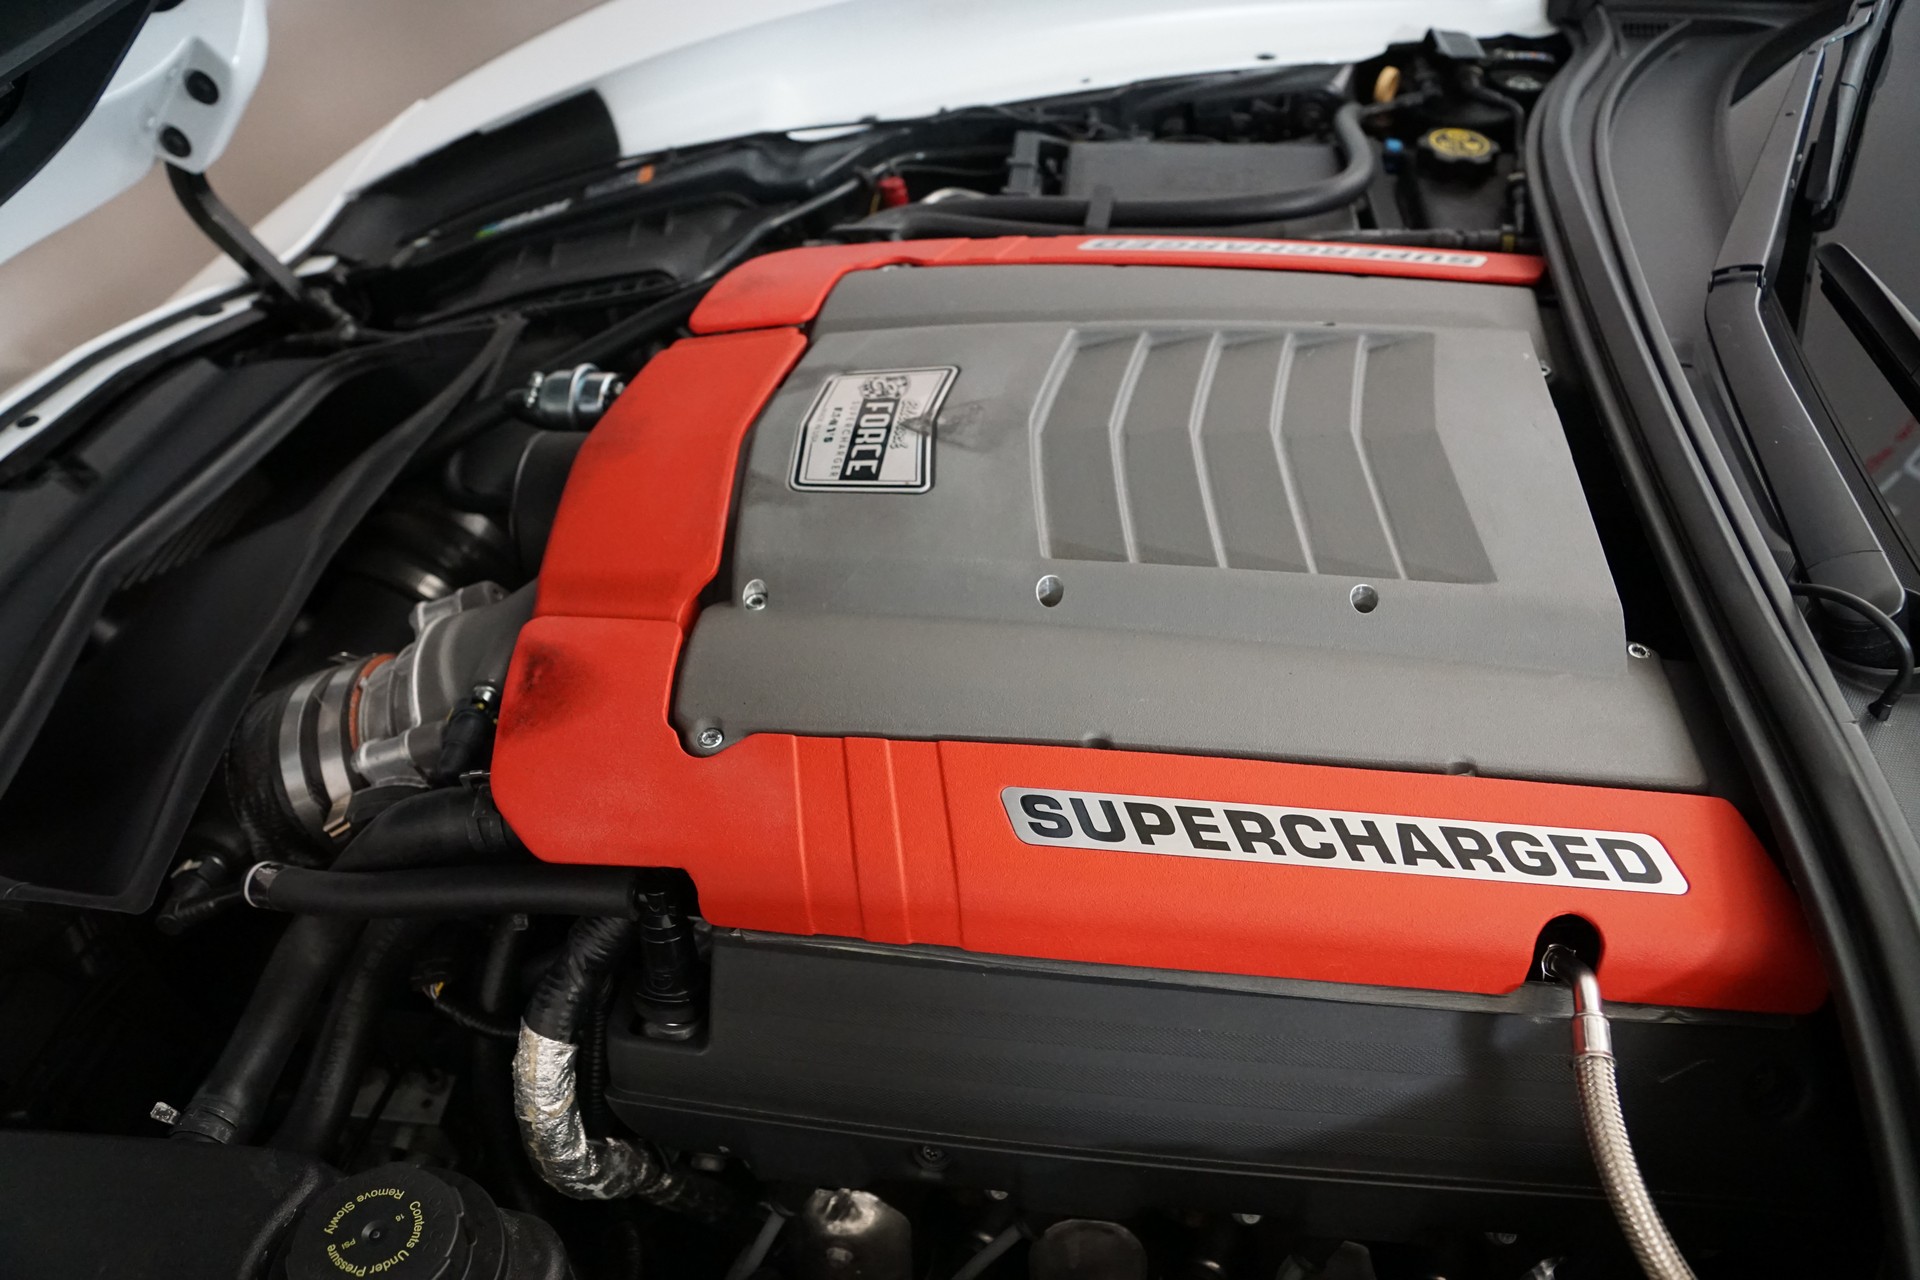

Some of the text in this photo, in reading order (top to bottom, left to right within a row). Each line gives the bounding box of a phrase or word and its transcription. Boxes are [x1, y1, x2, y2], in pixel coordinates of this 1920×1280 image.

[1092, 239, 1474, 264] SUPERCHARGED
[829, 401, 861, 477] SUPERCHARGER
[845, 401, 895, 476] FORCE
[1020, 794, 1664, 885] SUPERCHARGED
[324, 1188, 405, 1235] Remove Slowly
[406, 1200, 425, 1249] Contents
[327, 1243, 367, 1278] Pressure
[341, 1238, 356, 1250] PSI
[369, 1249, 410, 1275] Under
